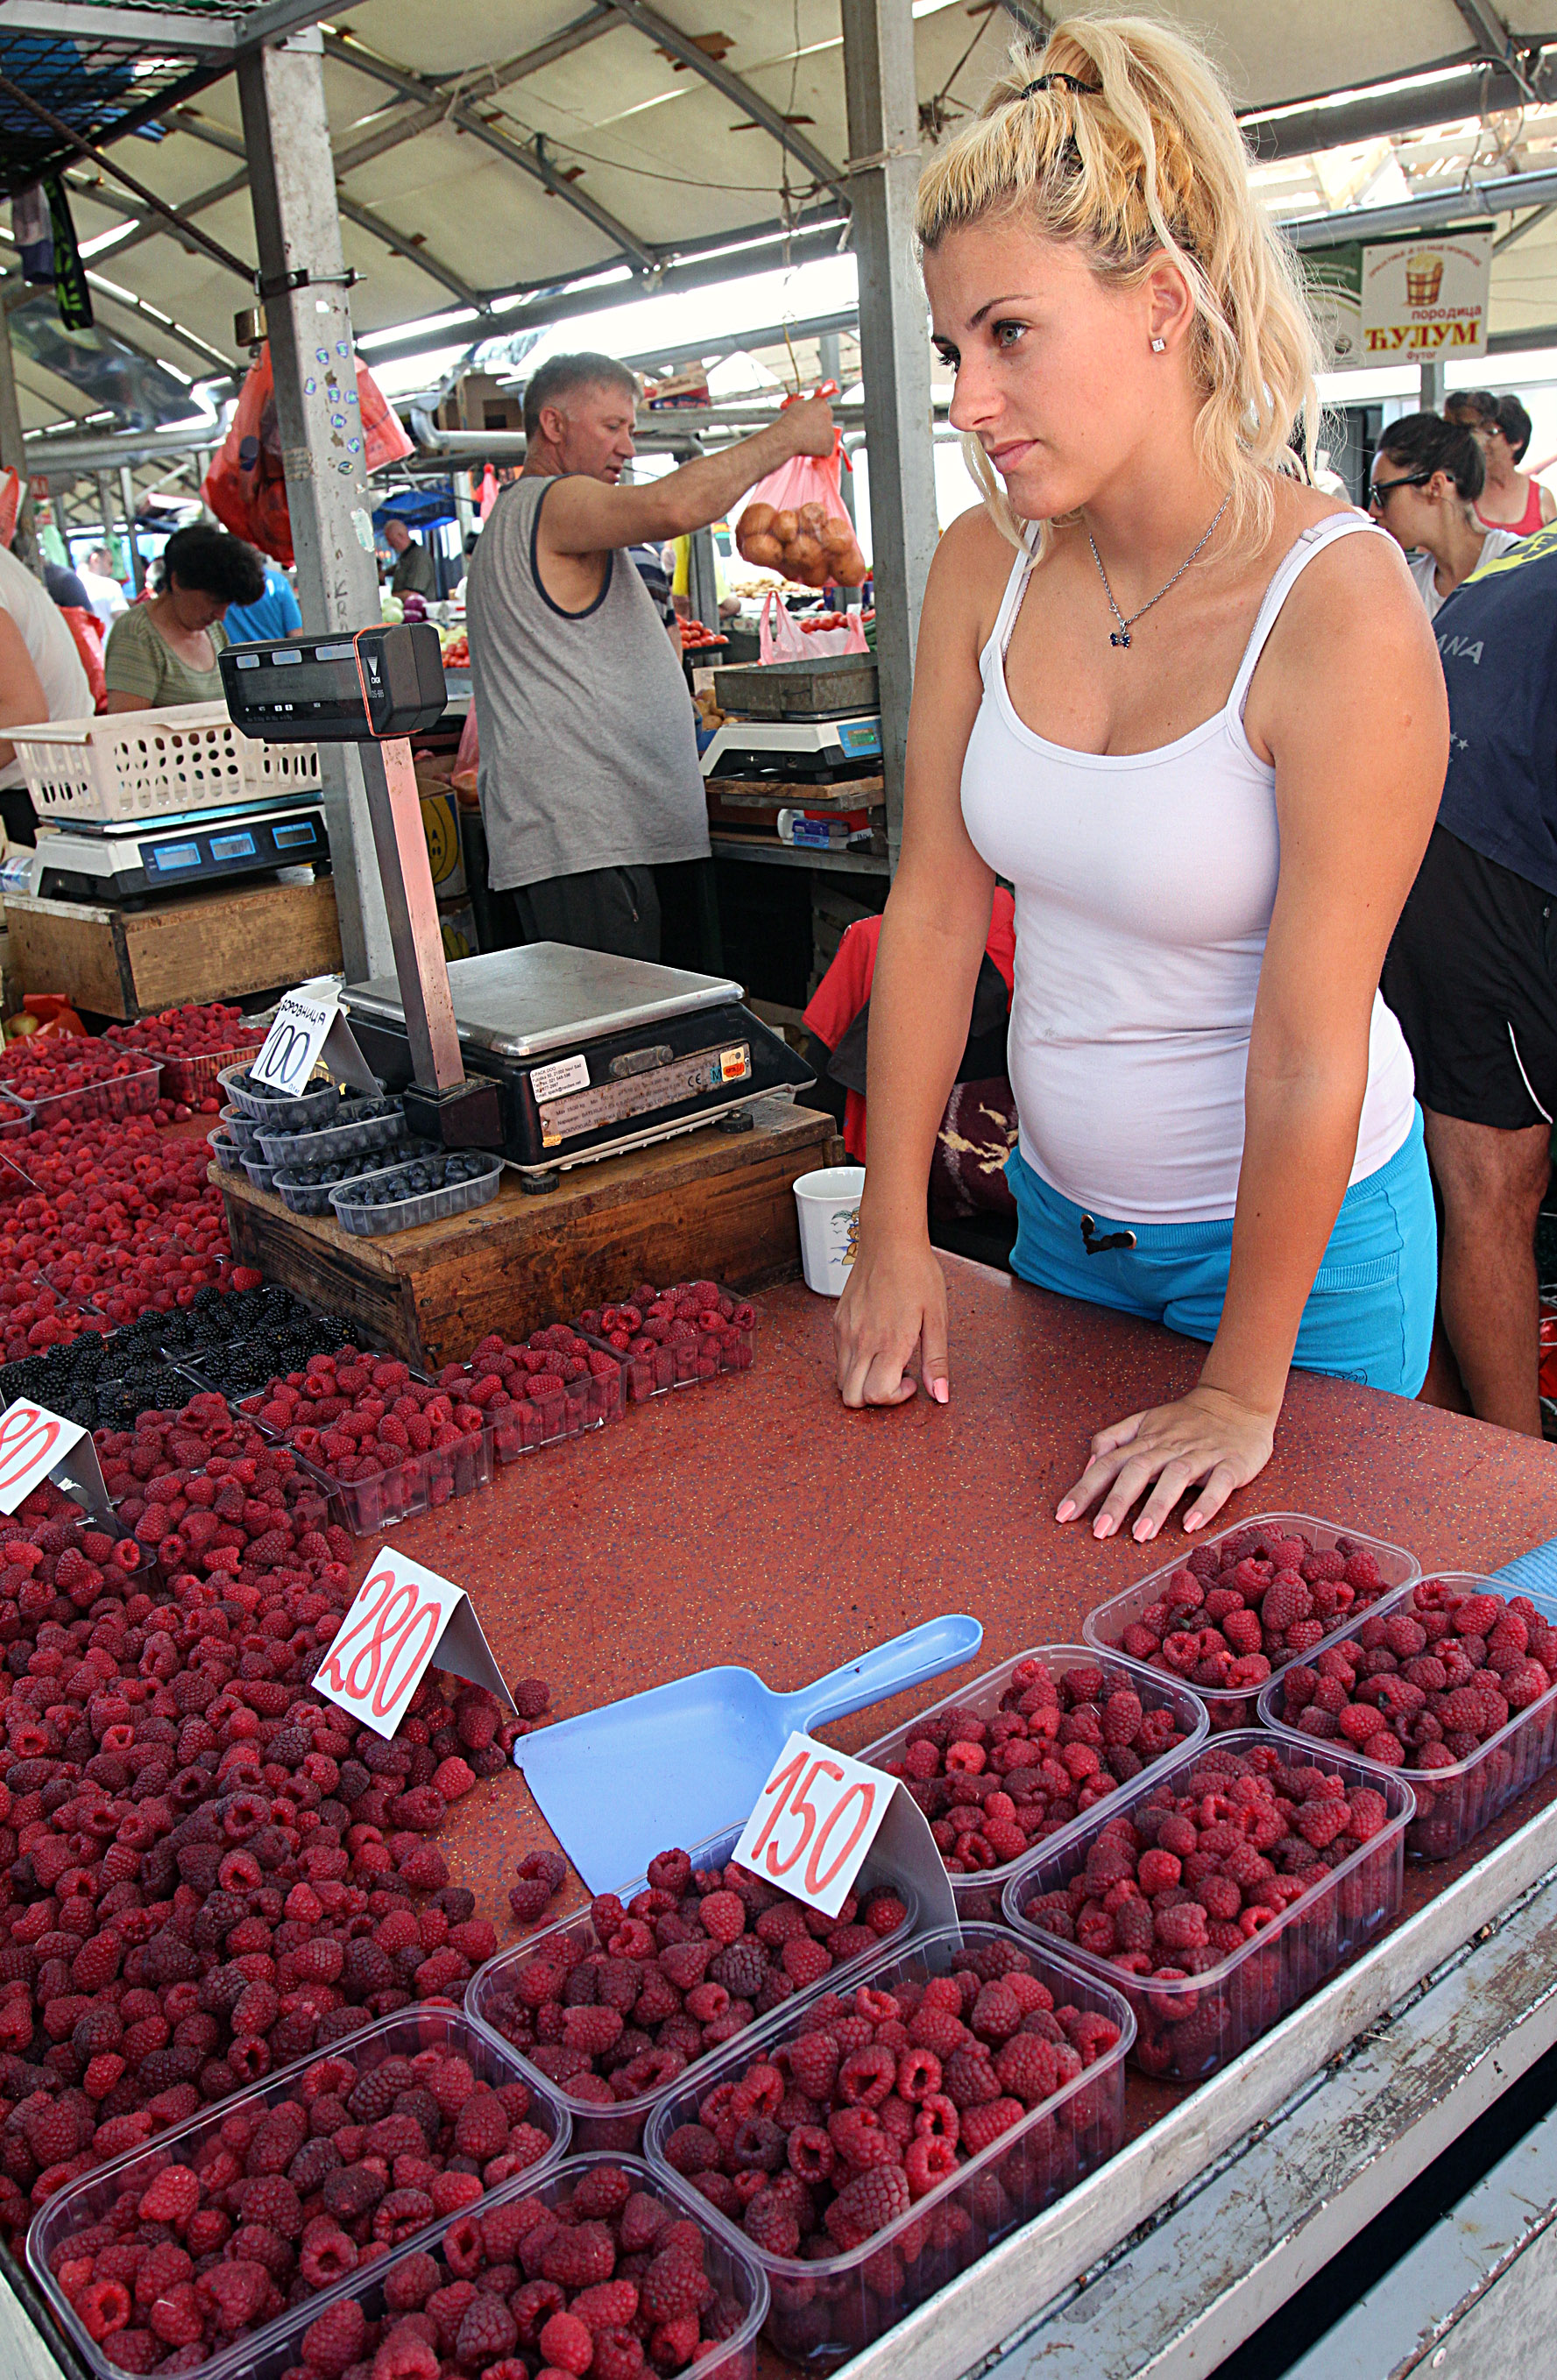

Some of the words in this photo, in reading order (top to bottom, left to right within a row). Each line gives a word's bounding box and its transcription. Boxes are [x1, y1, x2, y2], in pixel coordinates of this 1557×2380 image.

[258, 1020, 310, 1084] 100
[318, 1570, 442, 1717] 280
[751, 1751, 876, 1896] 150
